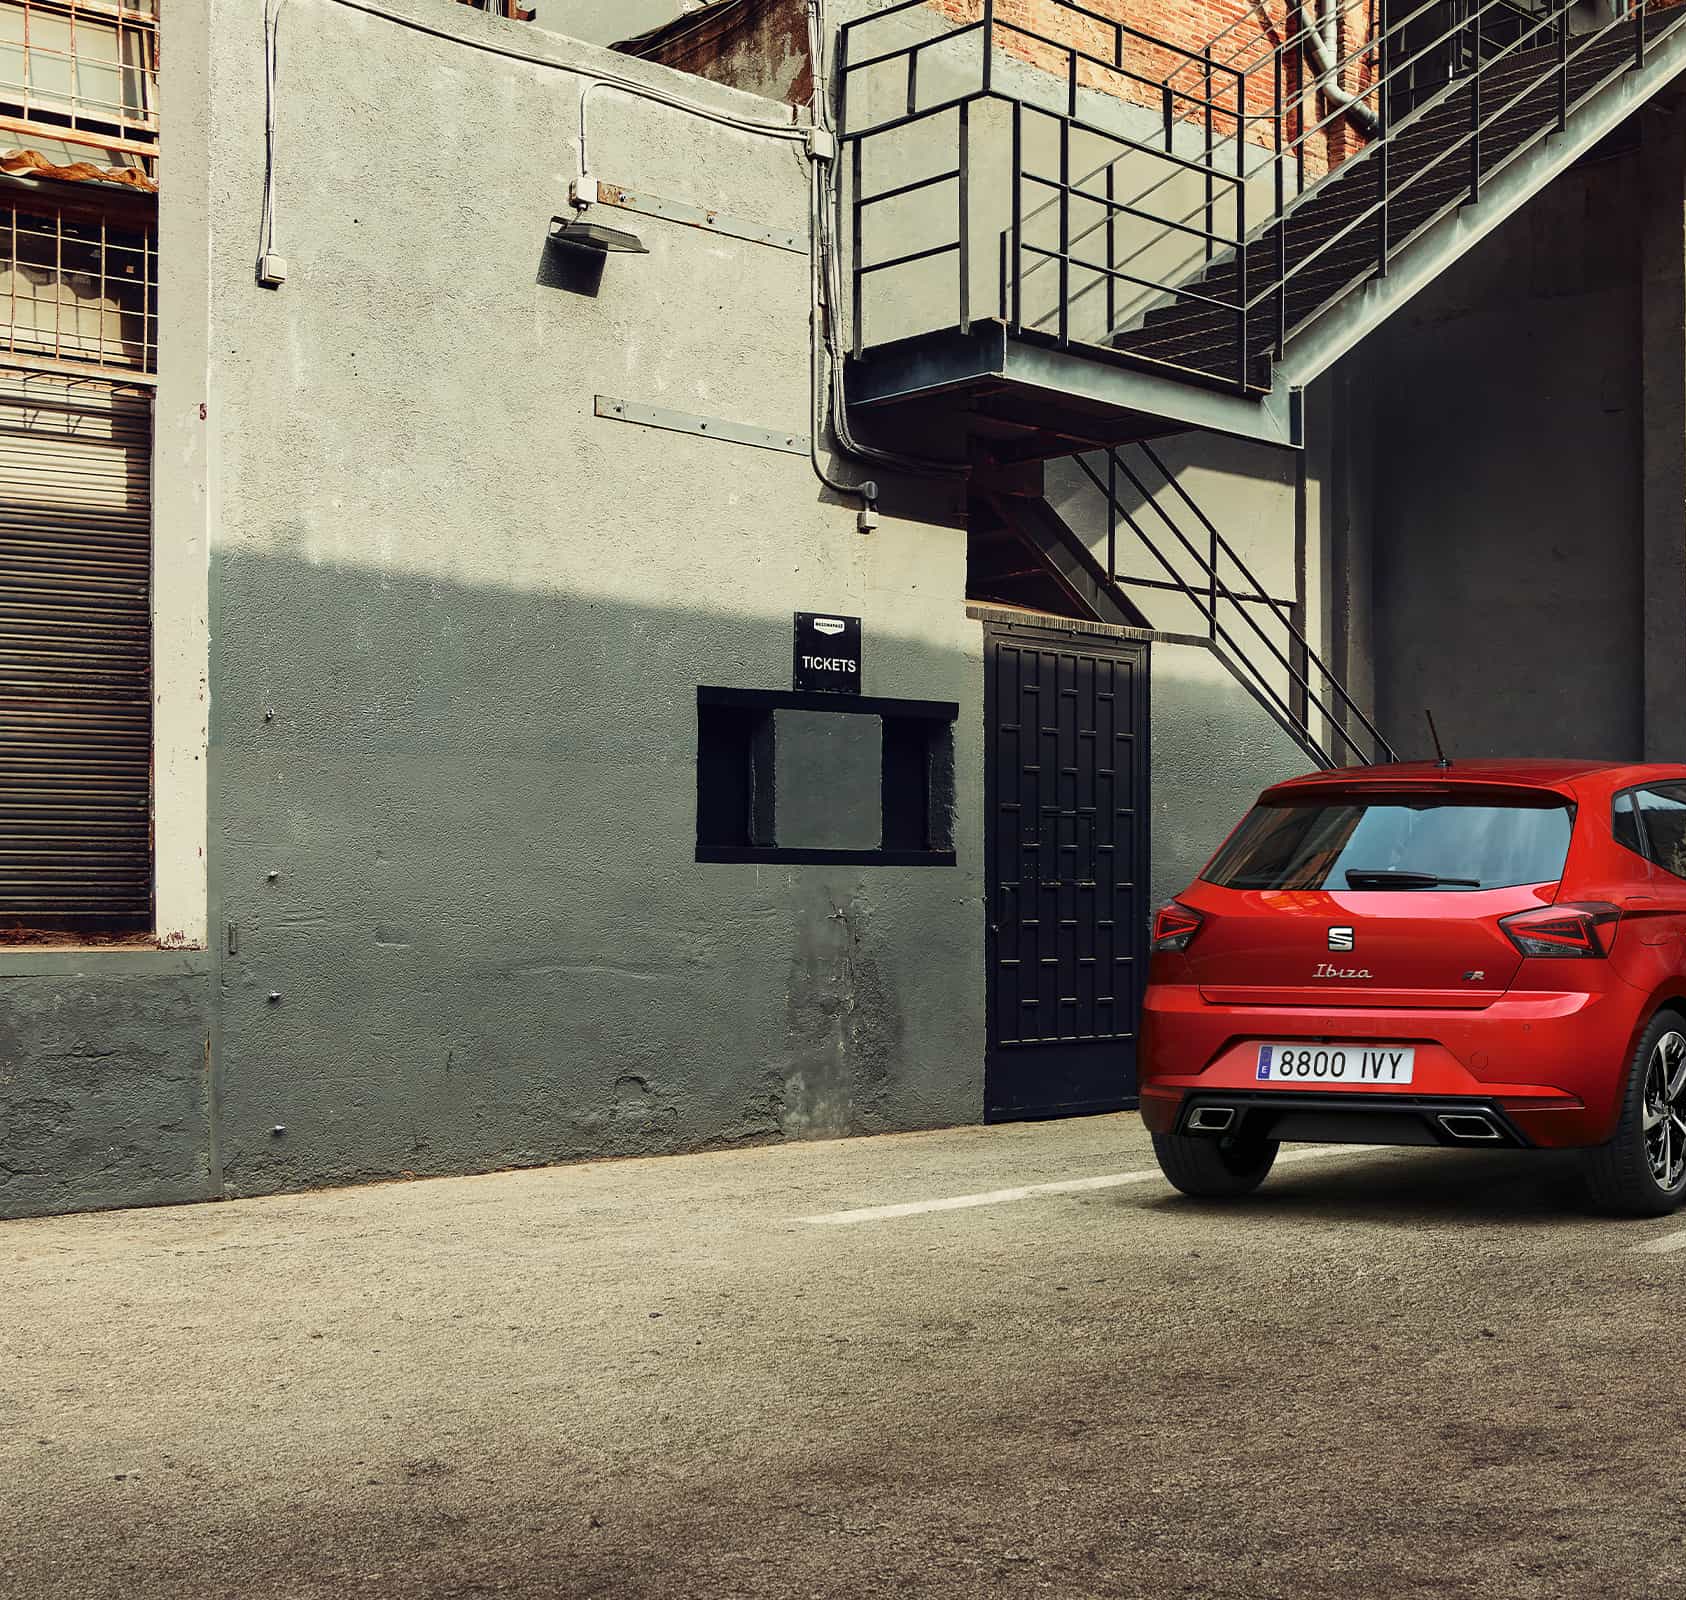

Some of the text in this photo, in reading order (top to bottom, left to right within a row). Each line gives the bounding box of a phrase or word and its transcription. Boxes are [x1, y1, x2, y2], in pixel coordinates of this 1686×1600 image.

[802, 655, 856, 673] TICKETS
[1312, 963, 1373, 978] Ibiza
[1261, 1050, 1403, 1079] E 8800 IVY
